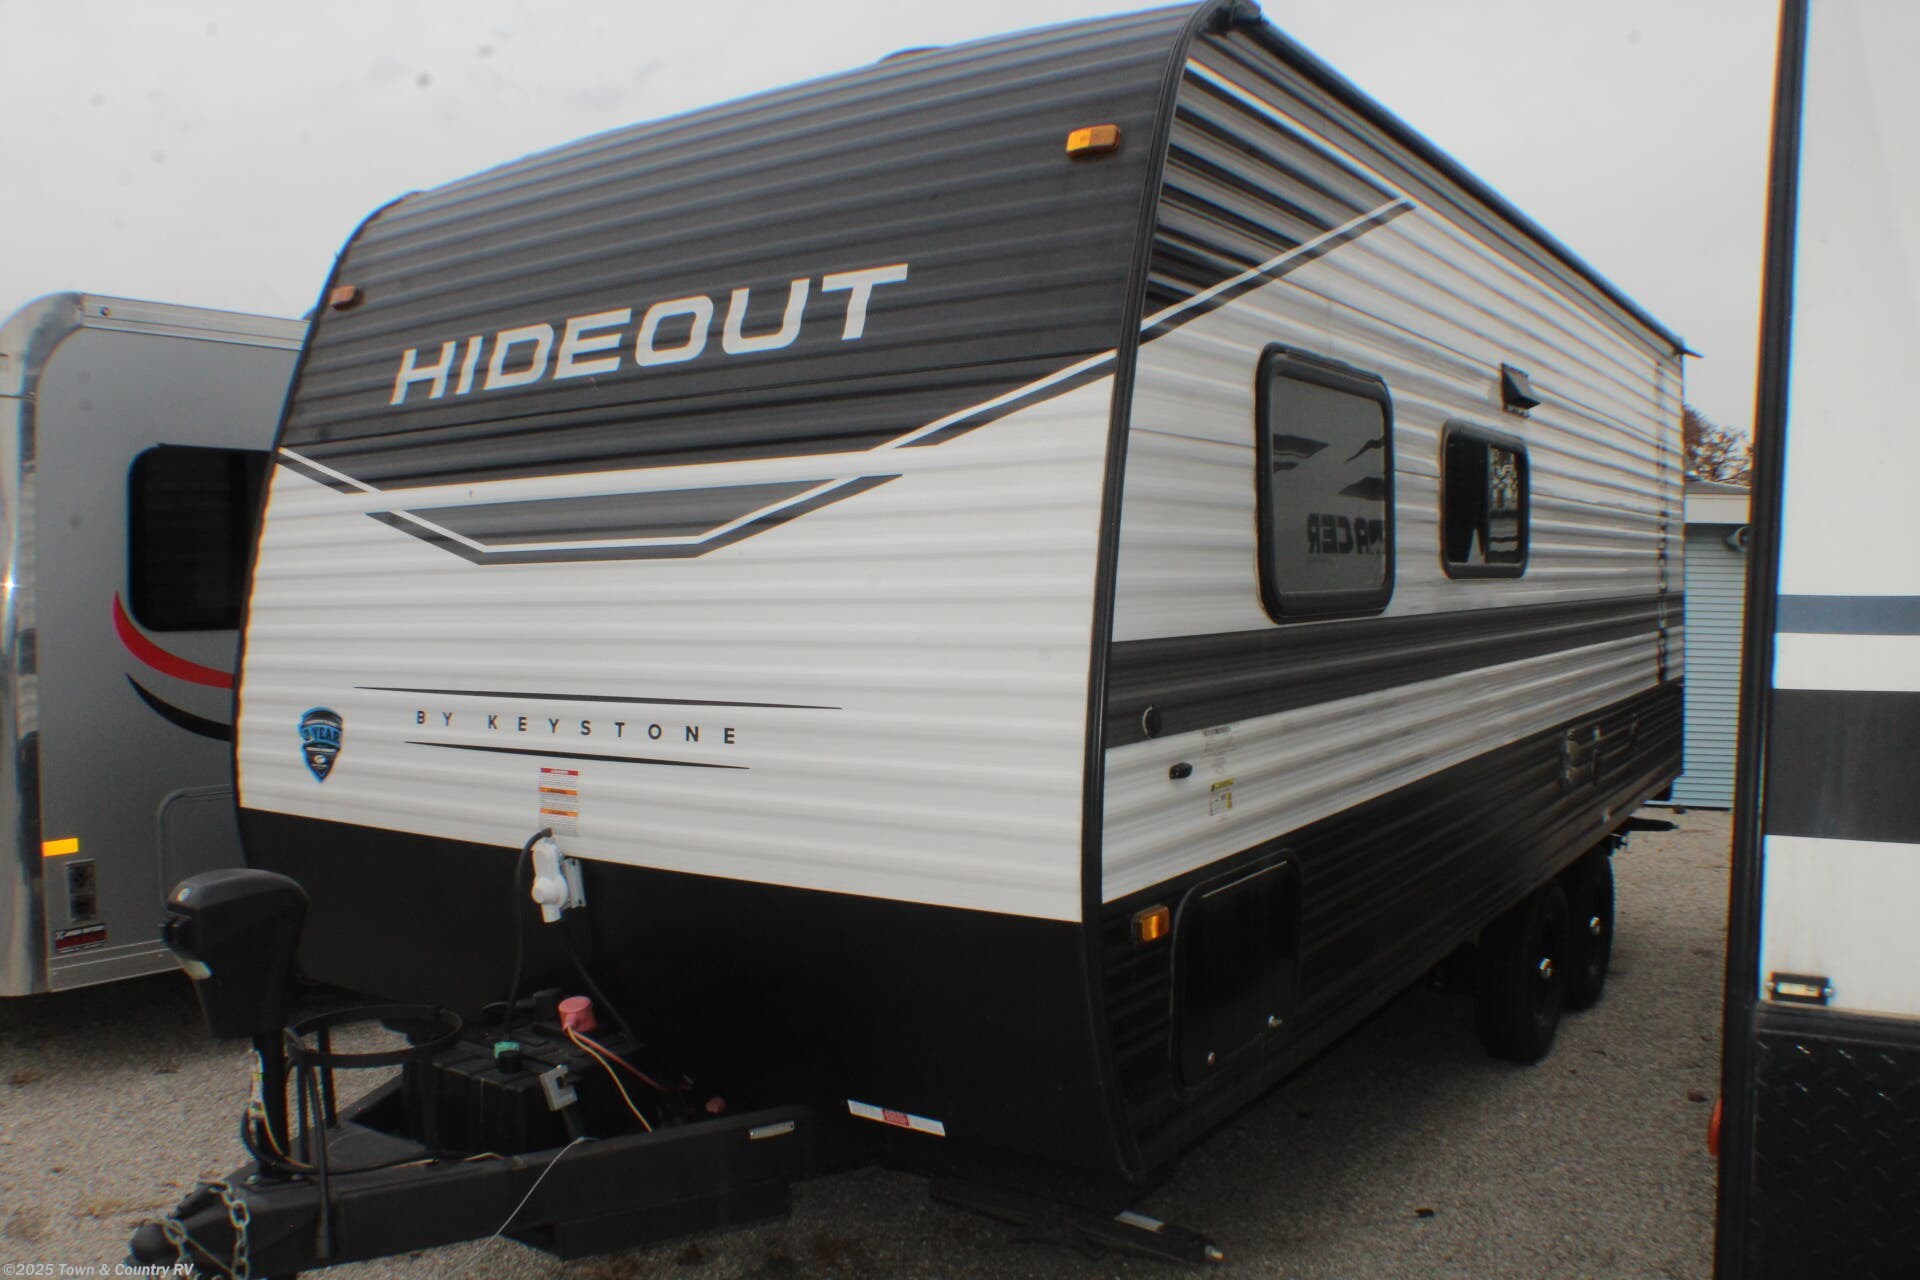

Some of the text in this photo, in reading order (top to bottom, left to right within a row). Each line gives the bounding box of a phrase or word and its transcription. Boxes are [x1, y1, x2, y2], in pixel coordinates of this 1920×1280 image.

[390, 263, 908, 405] HIDEOUT
[416, 710, 736, 745] BY KEYSTONE
